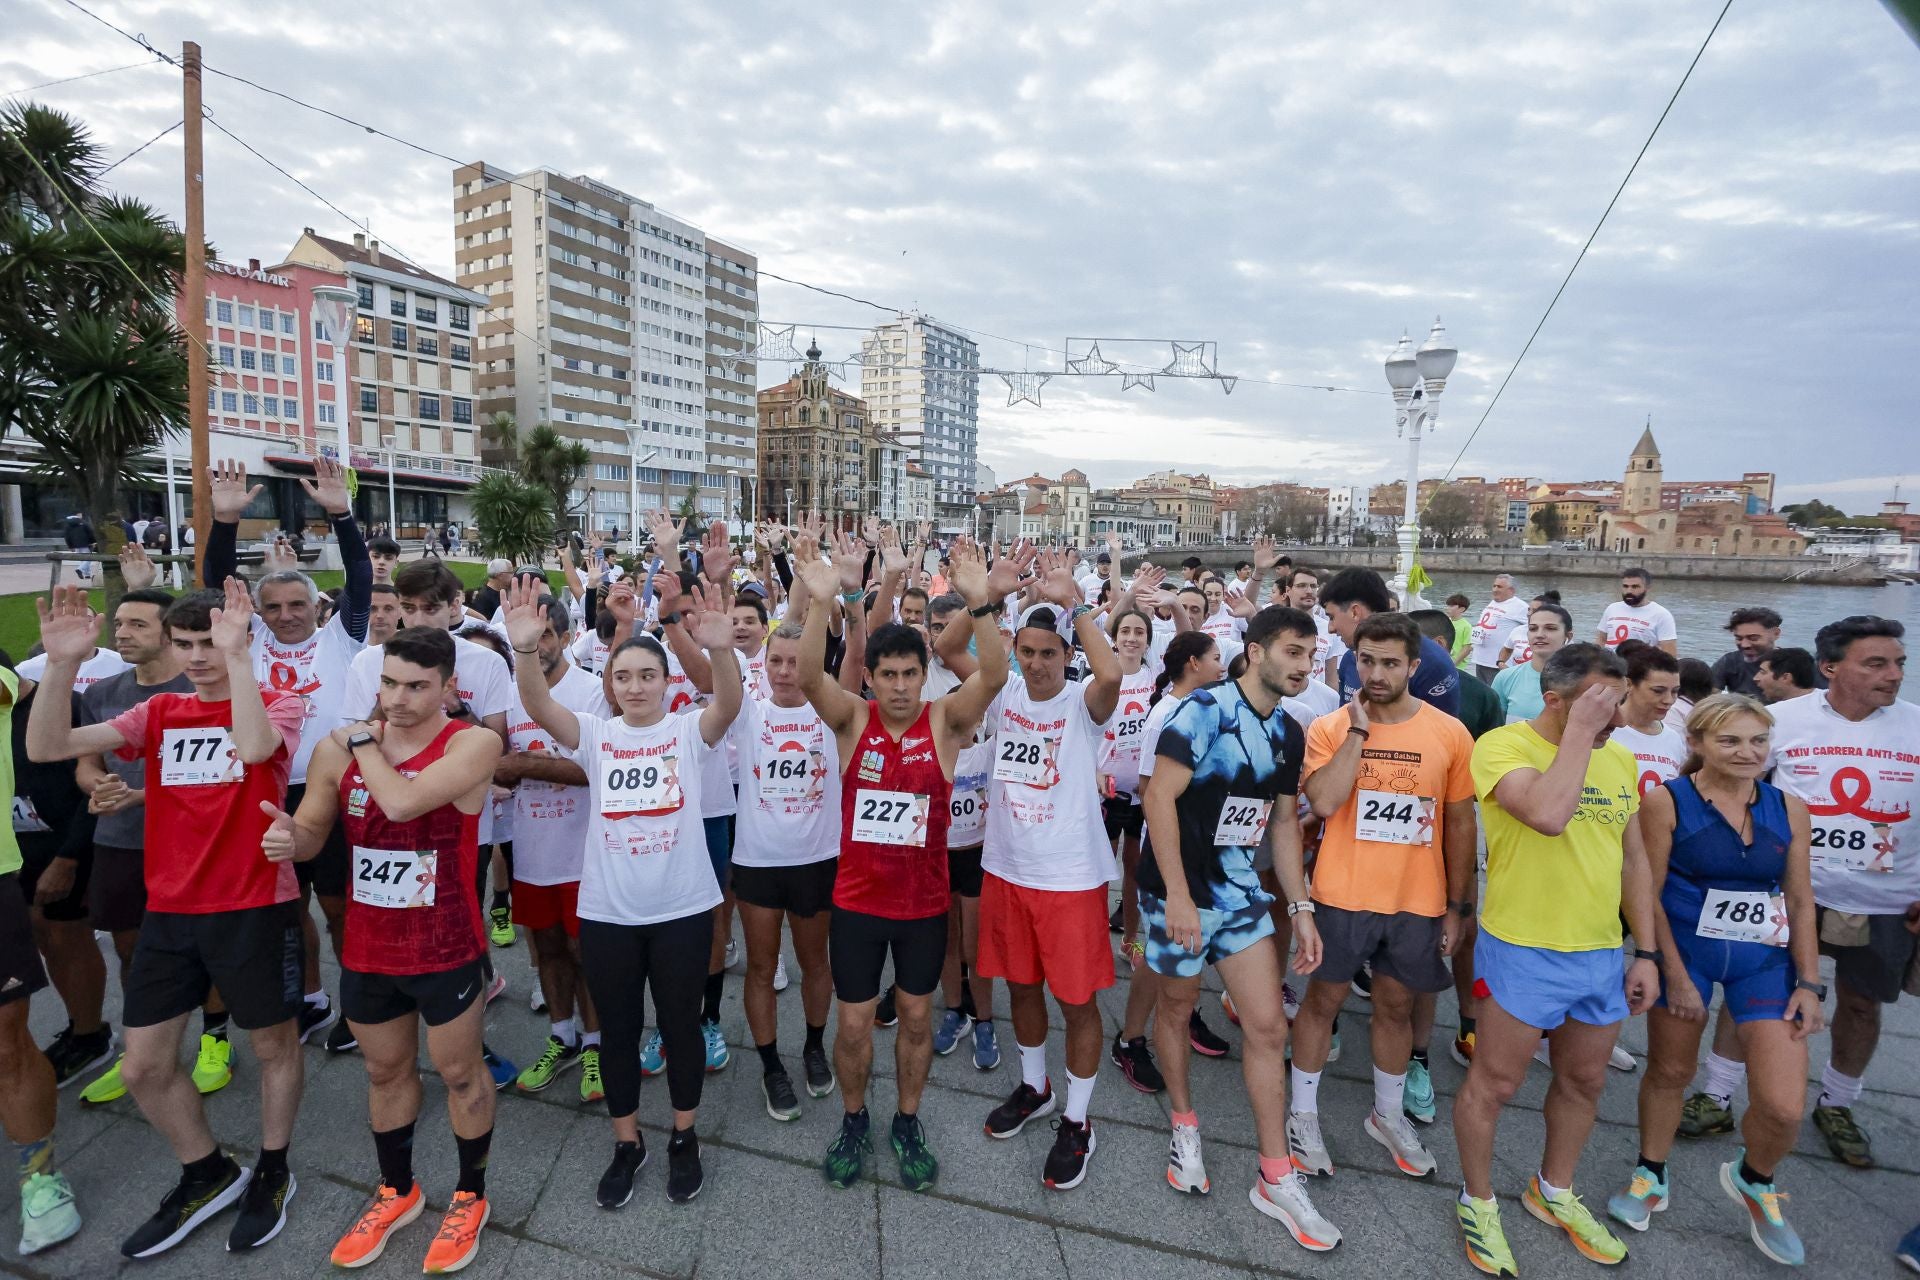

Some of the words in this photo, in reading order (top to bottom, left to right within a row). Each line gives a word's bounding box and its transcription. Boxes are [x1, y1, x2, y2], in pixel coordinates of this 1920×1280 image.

[172, 737, 222, 763] 177
[1000, 740, 1041, 765] 228
[1785, 747, 1810, 759] XXIV
[1812, 746, 1864, 757] CARRERA
[1866, 748, 1920, 766] ANTI-SIDA
[607, 766, 658, 791] 089
[767, 759, 807, 779] 164
[860, 798, 911, 823] 227
[1222, 805, 1258, 827] 242
[1363, 799, 1414, 824] 244
[1809, 827, 1867, 851] 268
[359, 858, 412, 885] 247
[1714, 900, 1766, 925] 188
